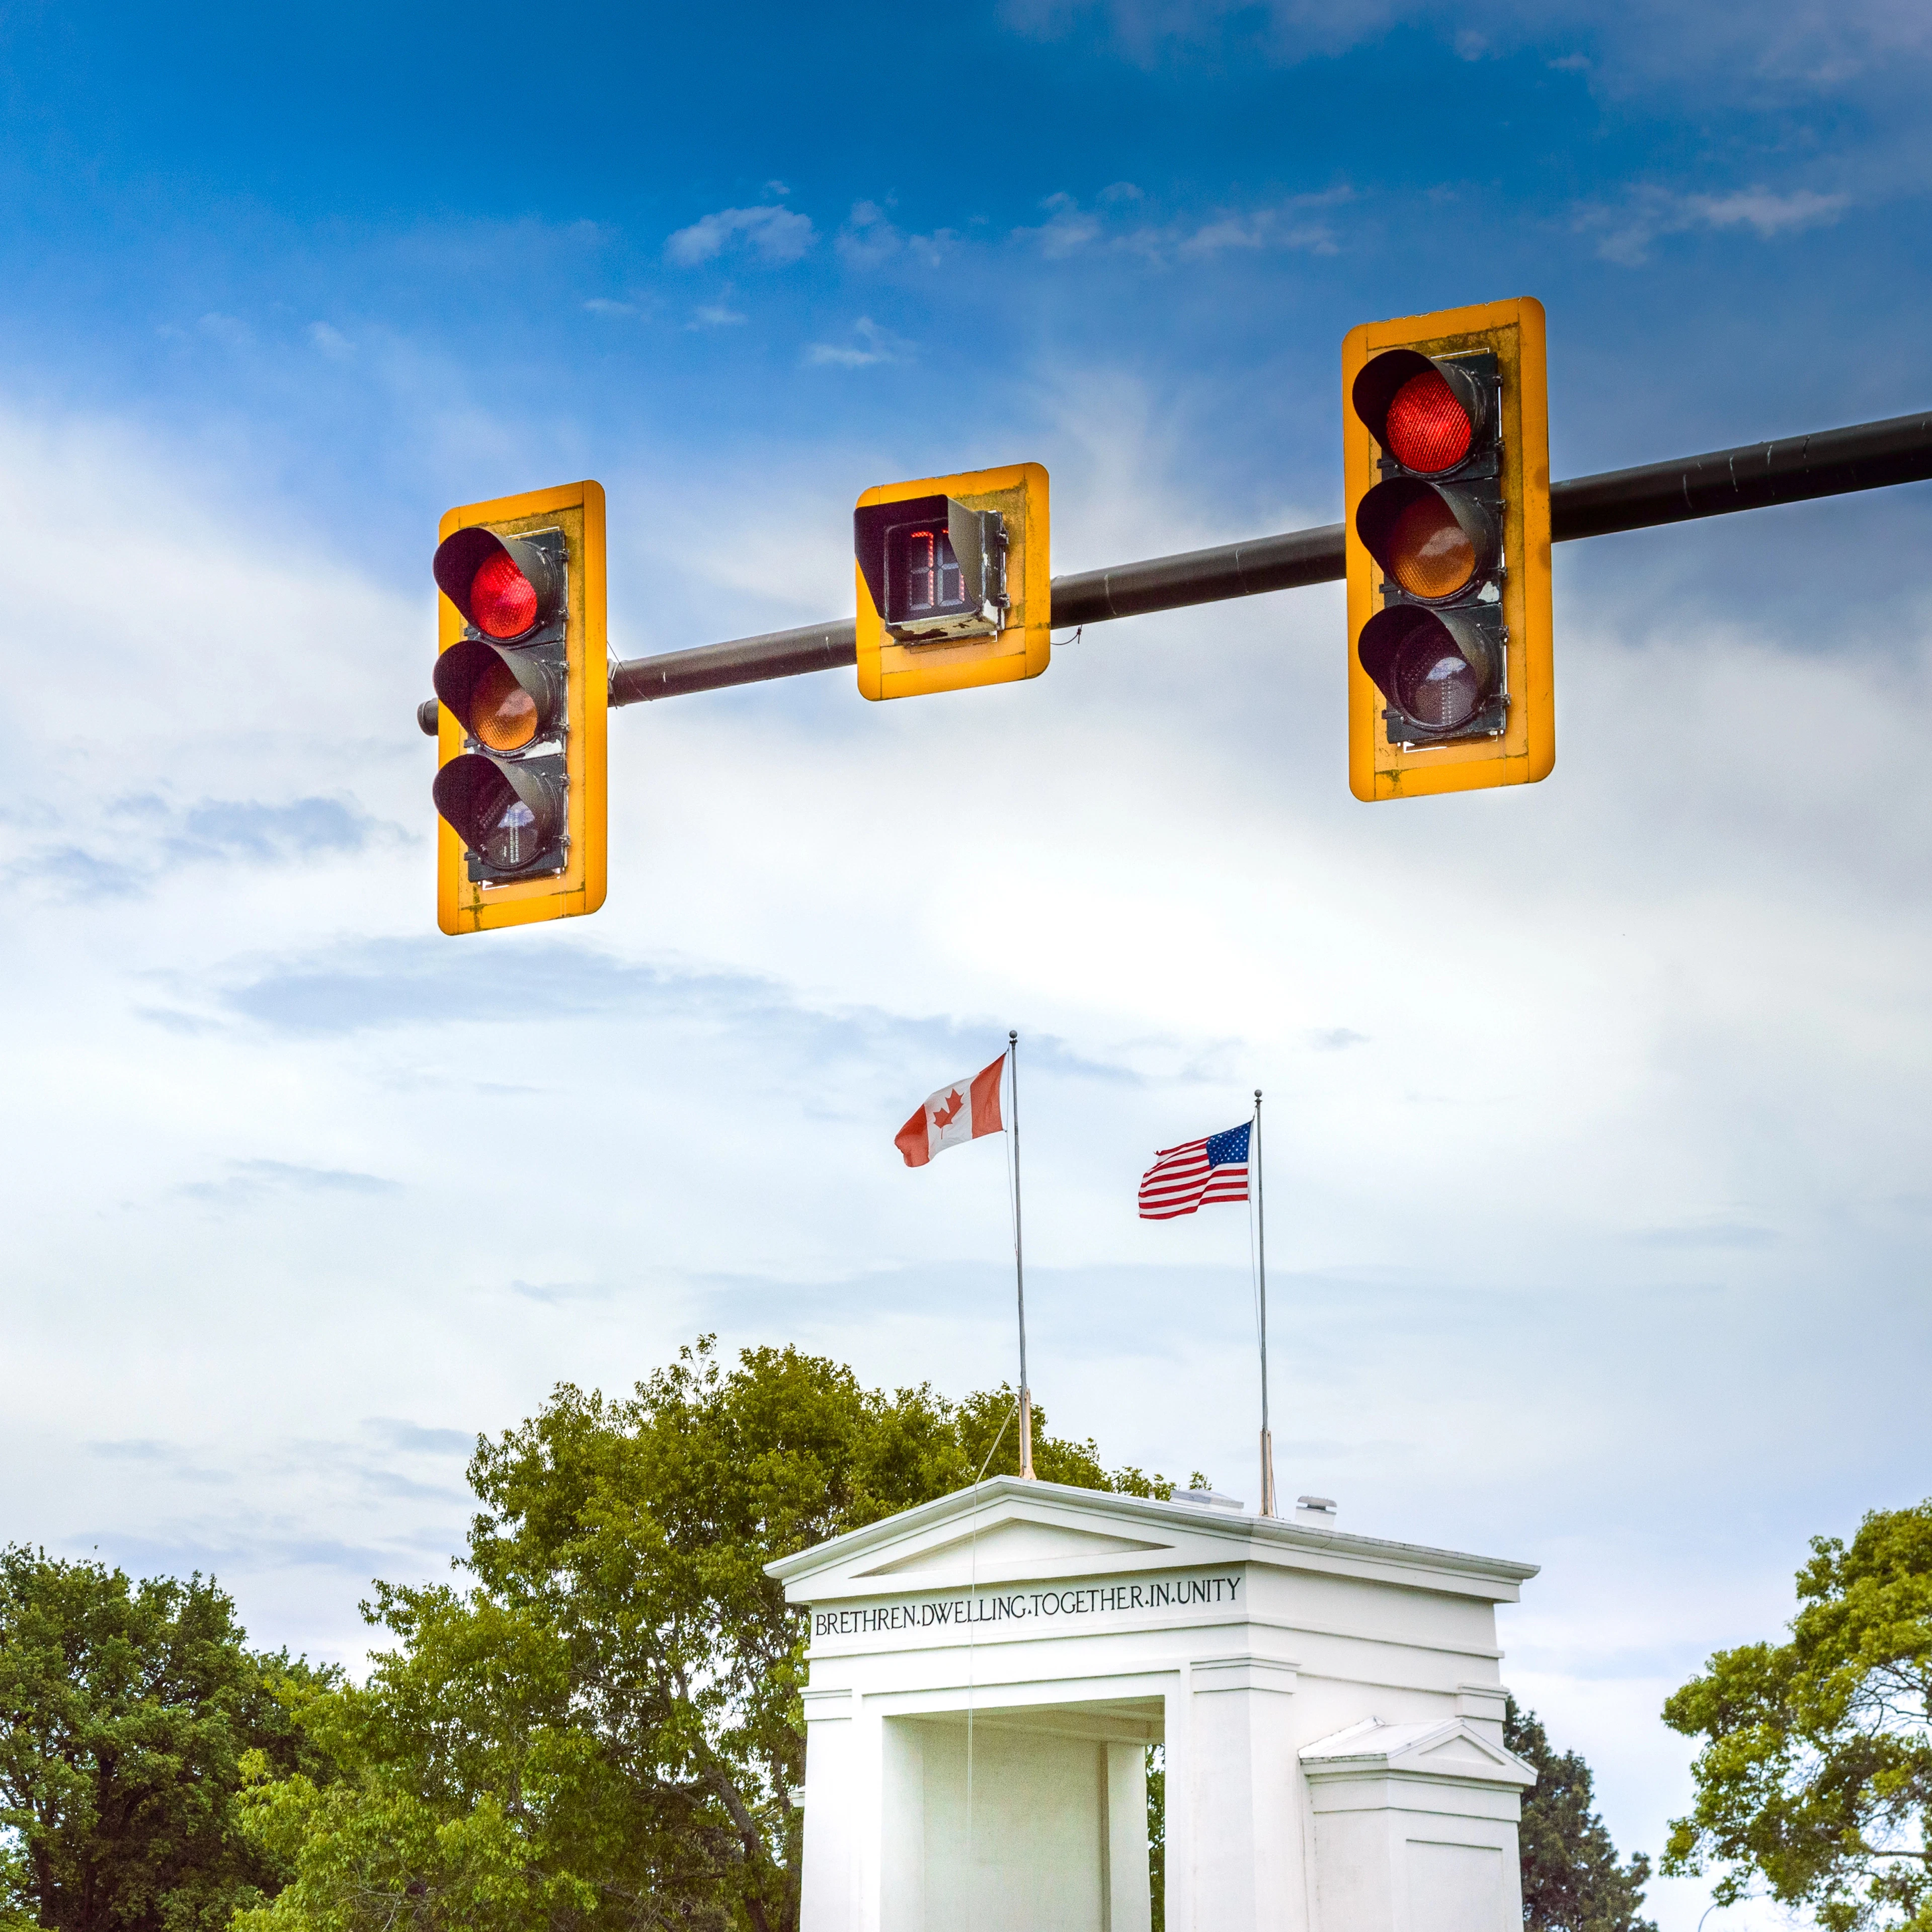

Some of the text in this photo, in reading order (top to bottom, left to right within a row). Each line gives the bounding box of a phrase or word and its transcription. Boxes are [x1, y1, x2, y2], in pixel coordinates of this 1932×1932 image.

[816, 1577, 1241, 1636] BRETHREN DWELLING TOGETHER IN UNITY
